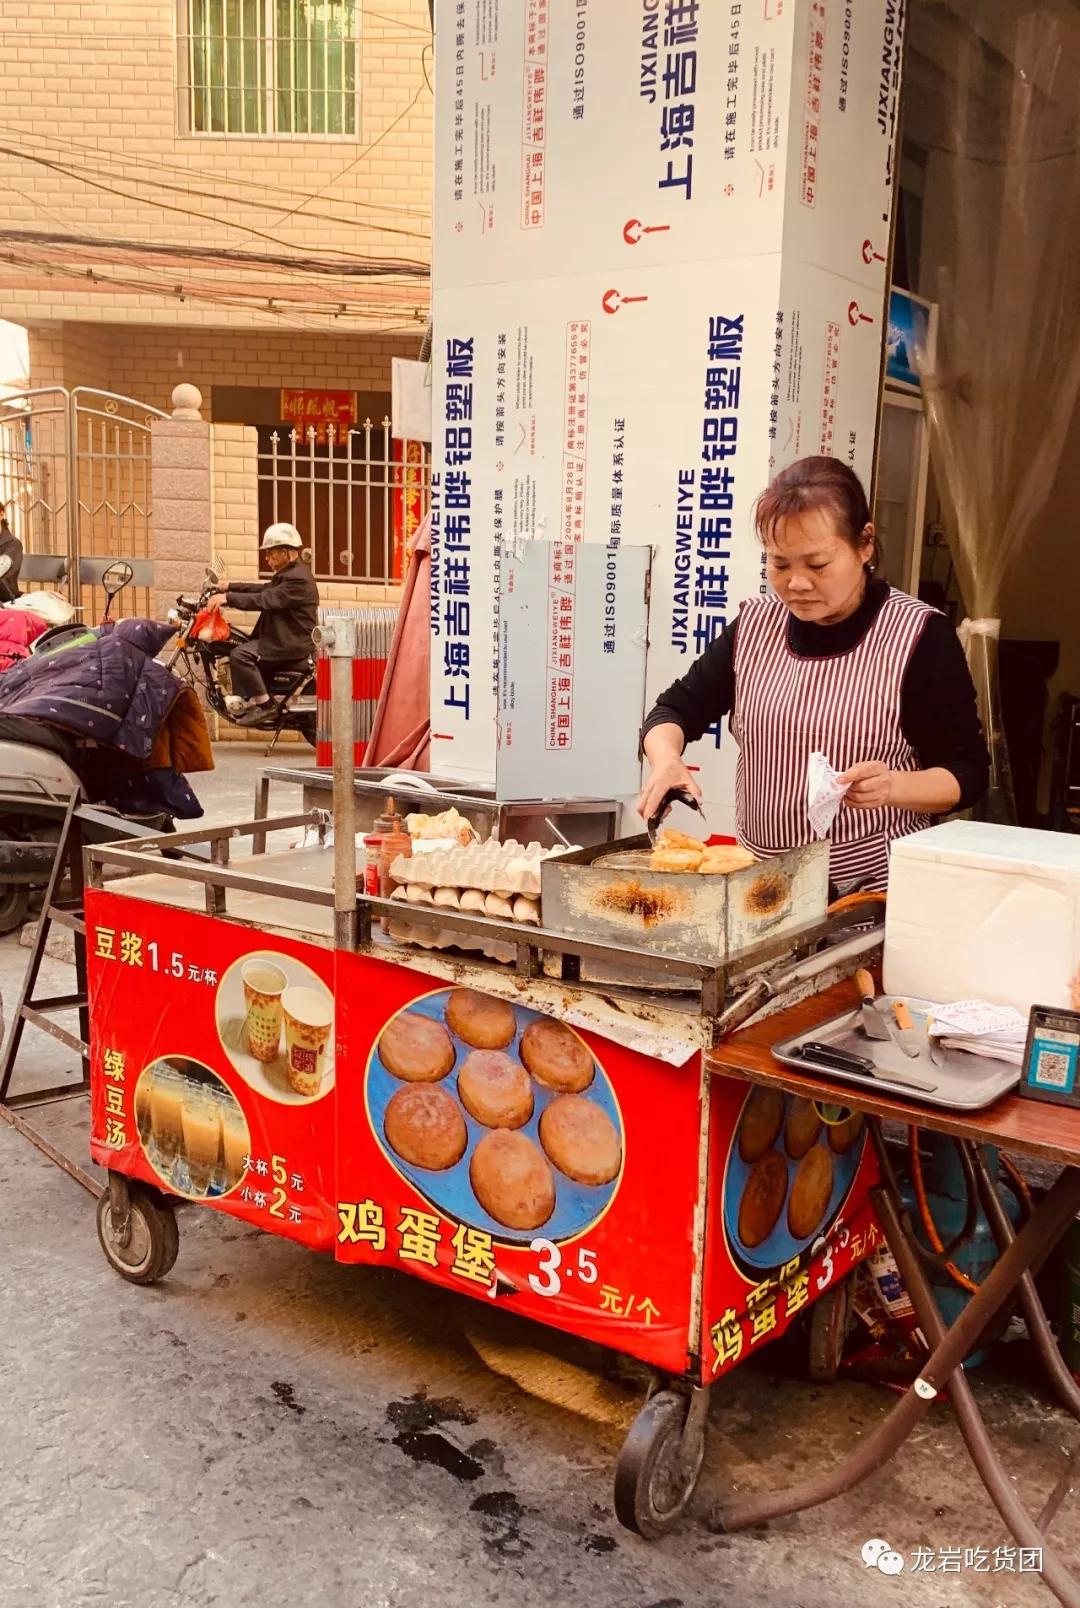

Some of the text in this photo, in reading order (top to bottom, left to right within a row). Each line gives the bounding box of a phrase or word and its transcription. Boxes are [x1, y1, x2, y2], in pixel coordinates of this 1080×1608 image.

[532, 67, 545, 143] 吉祥伟晔
[658, 0, 699, 200] 上海吉祥
[531, 152, 544, 225] 中国上海
[806, 123, 818, 203] 中国上海
[444, 336, 474, 720] 上海吉祥伟晔铝塑板
[671, 469, 695, 654] JIXIANGWEIYE
[558, 596, 573, 667] 吉祥伟晔
[549, 677, 557, 747] CHINA SHANGHAI
[556, 677, 571, 747] 中国上海
[103, 1047, 127, 1151] 绿豆汤
[241, 1186, 302, 1224] 小杯2元
[242, 1154, 304, 1192] 大杯5元
[337, 1199, 496, 1288] 鸡蛋堡
[711, 1256, 810, 1375] 鸡蛋堡
